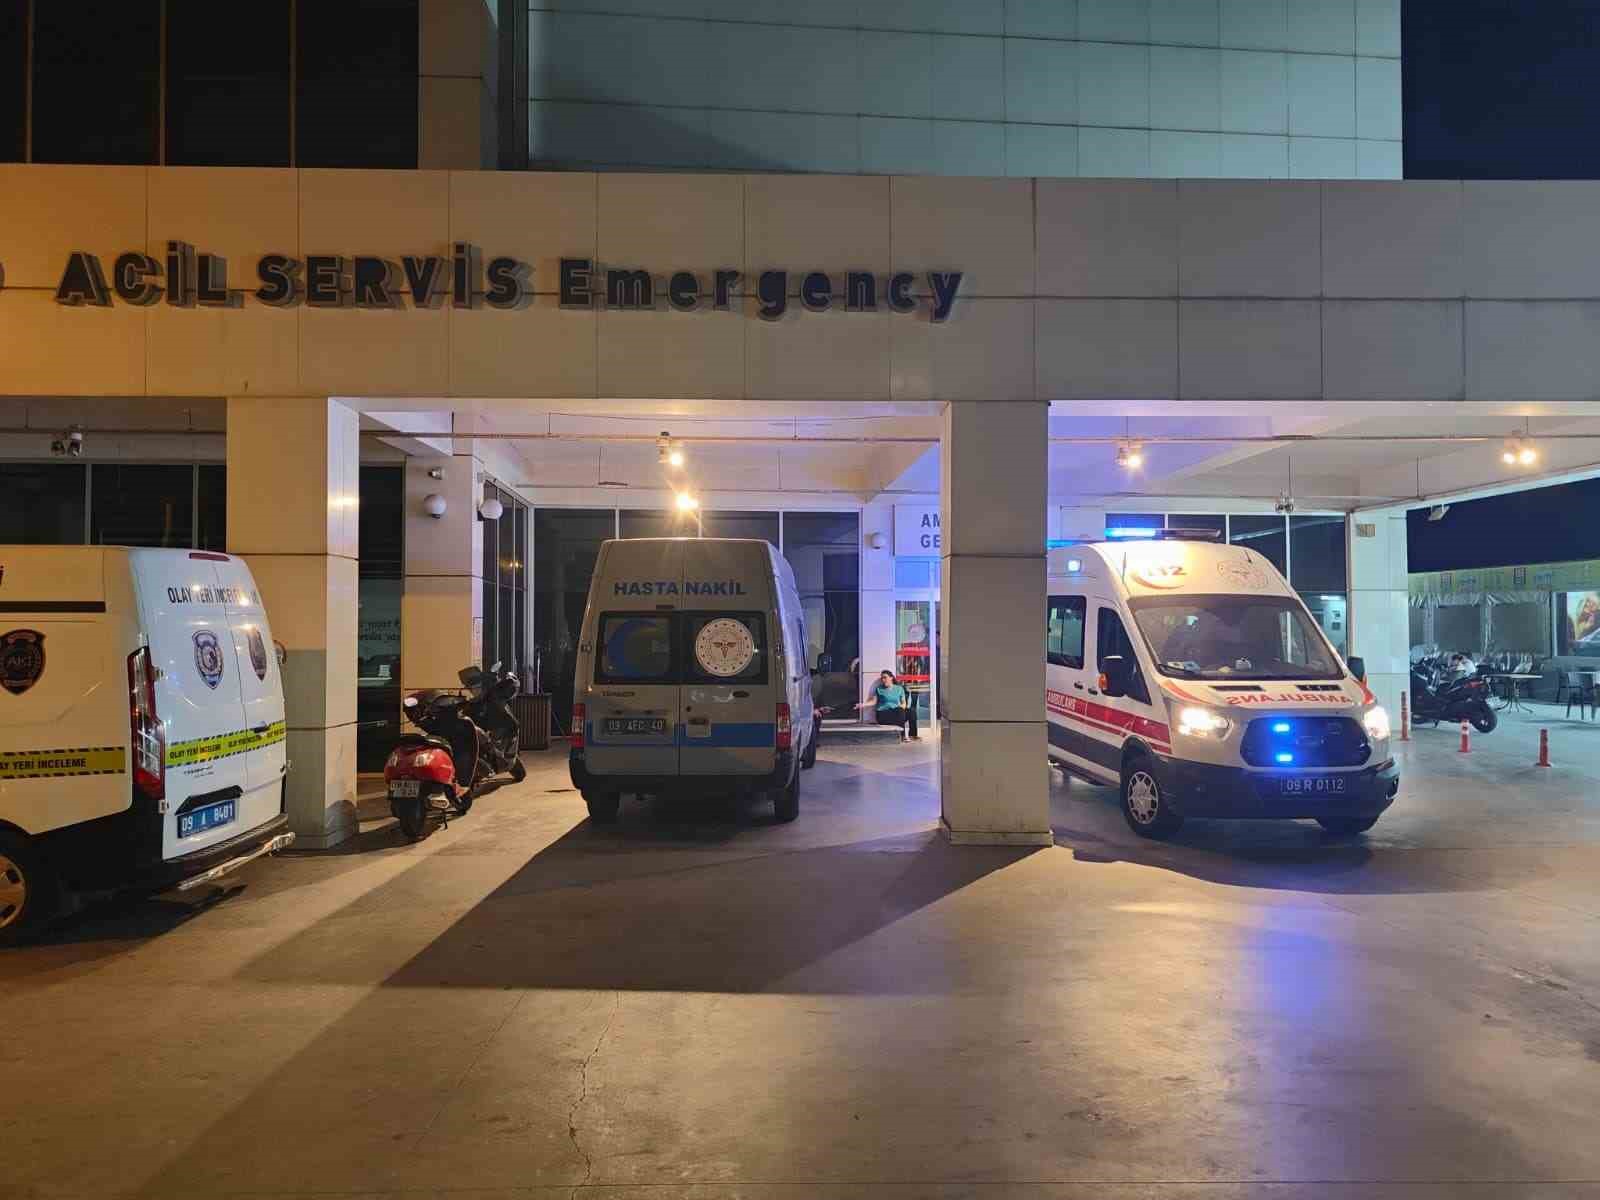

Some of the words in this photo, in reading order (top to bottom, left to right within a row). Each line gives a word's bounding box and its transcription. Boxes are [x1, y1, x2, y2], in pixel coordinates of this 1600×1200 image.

[256, 242, 530, 308] SERVİS
[558, 257, 964, 324] Emergency
[168, 587, 192, 603] OLAY
[613, 581, 679, 596] HASTA
[684, 579, 747, 595] NAKİL
[38, 757, 87, 769] İNCELEME
[1286, 779, 1301, 791] 09
[1303, 779, 1313, 791] R
[1315, 778, 1344, 791] 0112
[181, 816, 194, 832] 09
